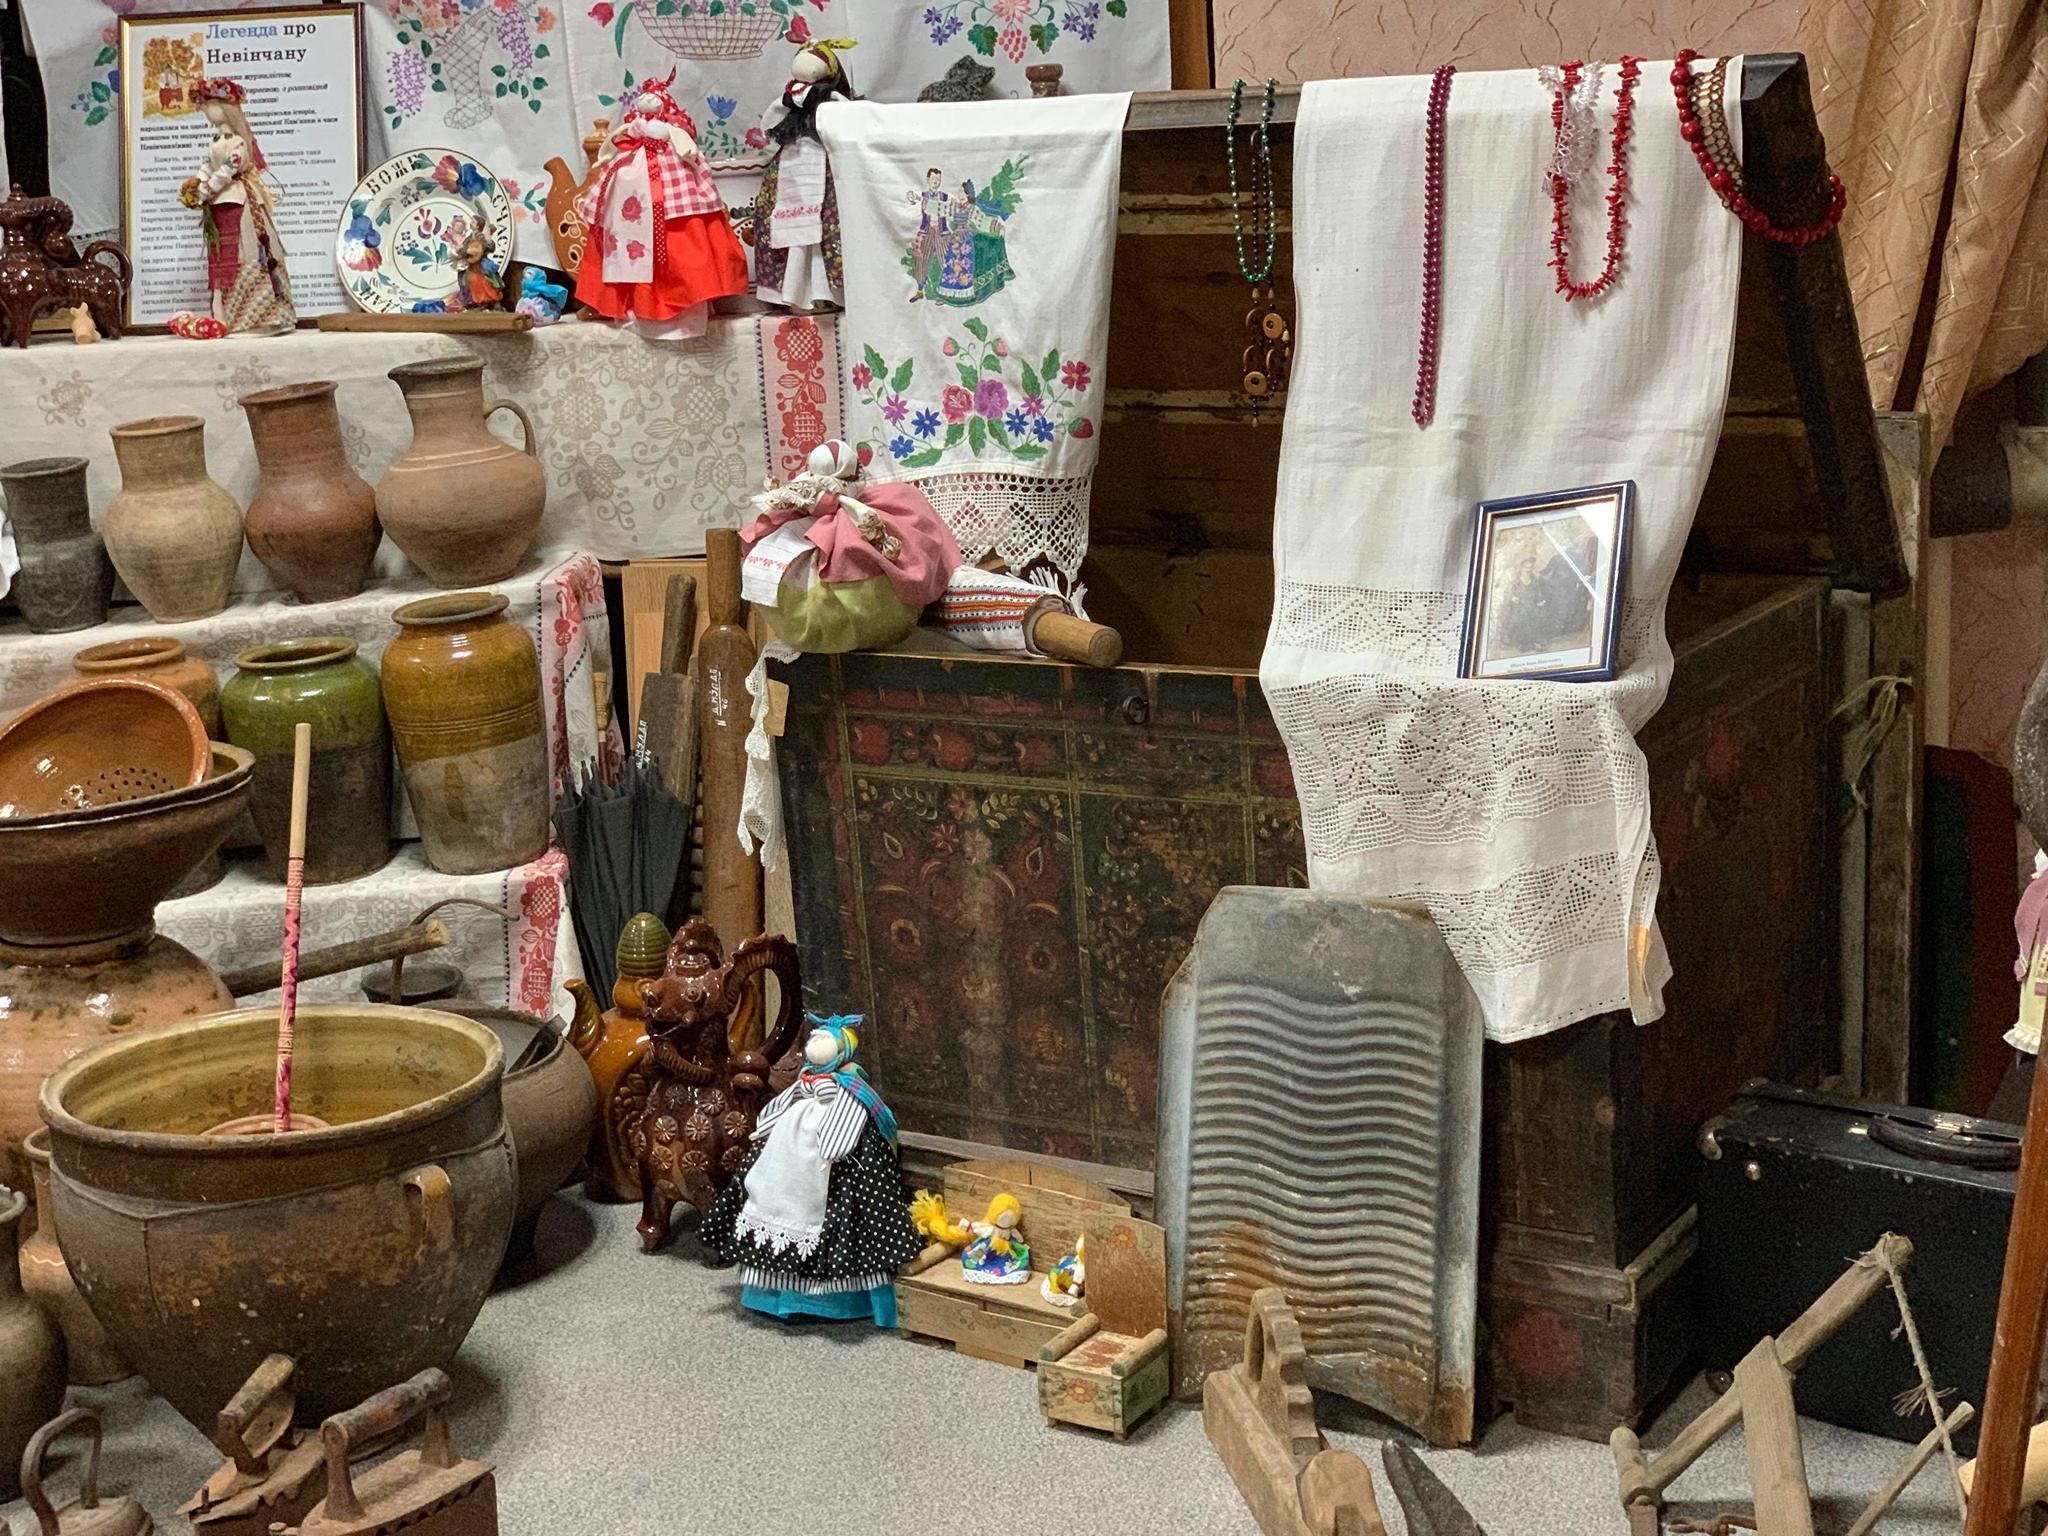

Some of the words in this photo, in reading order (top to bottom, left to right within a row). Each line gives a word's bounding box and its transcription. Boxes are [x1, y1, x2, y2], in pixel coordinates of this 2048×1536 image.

[205, 23, 279, 39] Легенда
[283, 23, 316, 37] про
[206, 47, 307, 64] Невінчану
[364, 153, 422, 195] БОЖЕ
